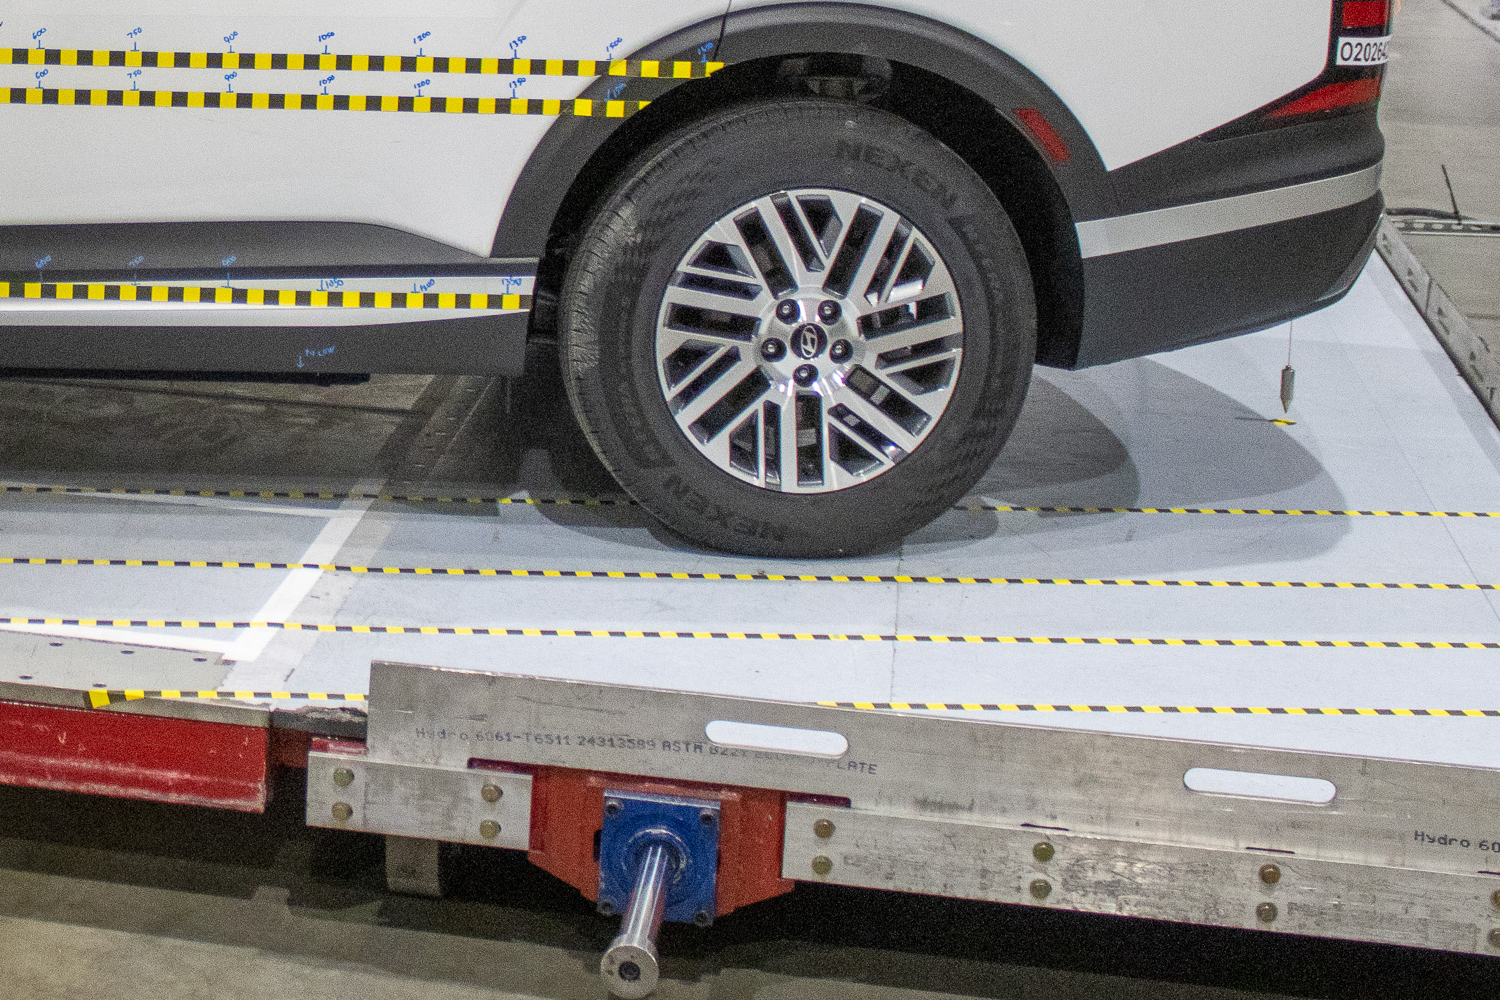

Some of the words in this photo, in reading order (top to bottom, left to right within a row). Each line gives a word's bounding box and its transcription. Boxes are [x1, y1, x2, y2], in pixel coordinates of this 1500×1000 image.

[32, 27, 47, 40] 600
[835, 139, 959, 211] NEXEN
[663, 472, 788, 542] NEXEN
[1414, 830, 1470, 848] Hydro
